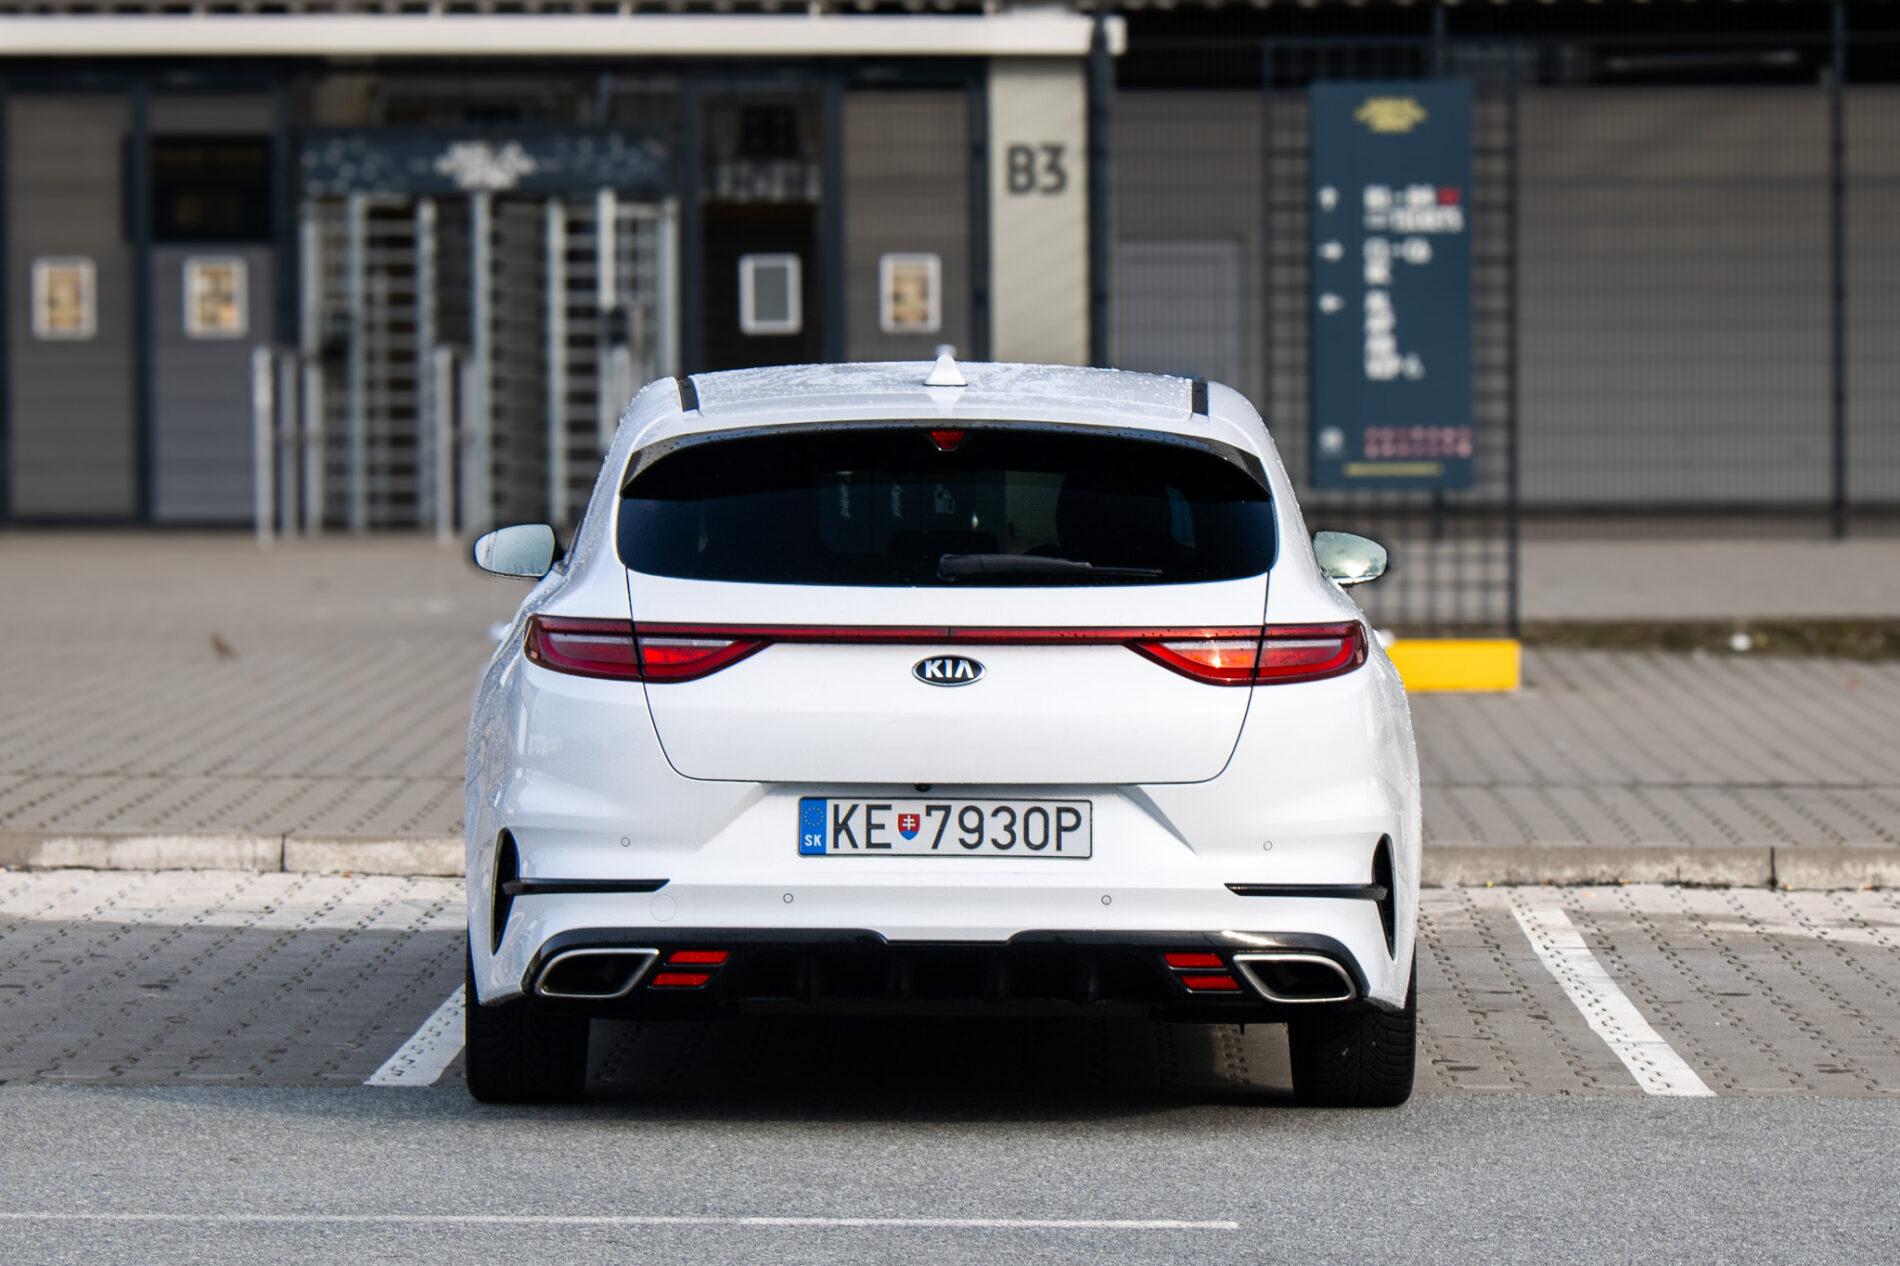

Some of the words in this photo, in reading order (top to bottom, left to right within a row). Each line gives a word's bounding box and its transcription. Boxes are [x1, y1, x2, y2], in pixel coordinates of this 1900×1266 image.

[1007, 144, 1068, 196] B3
[924, 659, 974, 678] KIA
[804, 834, 822, 847] SK
[833, 804, 892, 849] KE
